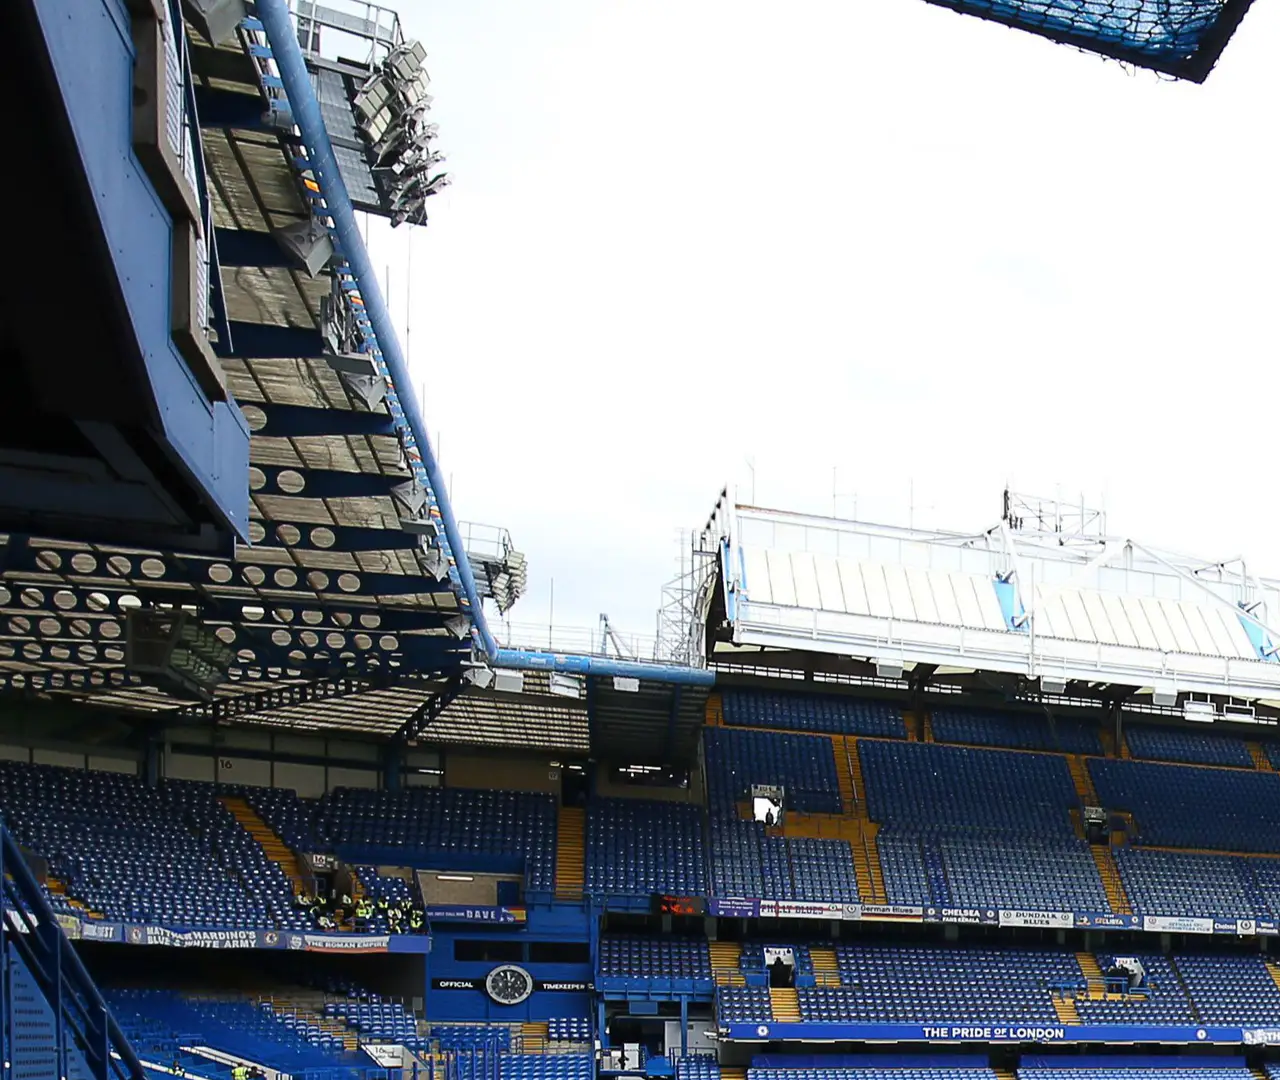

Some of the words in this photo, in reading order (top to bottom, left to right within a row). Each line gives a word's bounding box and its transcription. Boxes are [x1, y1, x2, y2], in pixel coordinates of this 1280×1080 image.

[220, 759, 232, 769] 16
[466, 910, 496, 919] DAVE
[942, 909, 980, 917] CHELSEA
[192, 931, 256, 940] HARDING'S
[147, 936, 170, 945] BLUE
[184, 940, 219, 949] WHITE
[224, 940, 256, 948] ARMY
[922, 1028, 948, 1038] THE
[952, 1028, 991, 1038] PRIDE
[994, 1027, 1007, 1038] OF
[1009, 1028, 1064, 1038] LONDON
